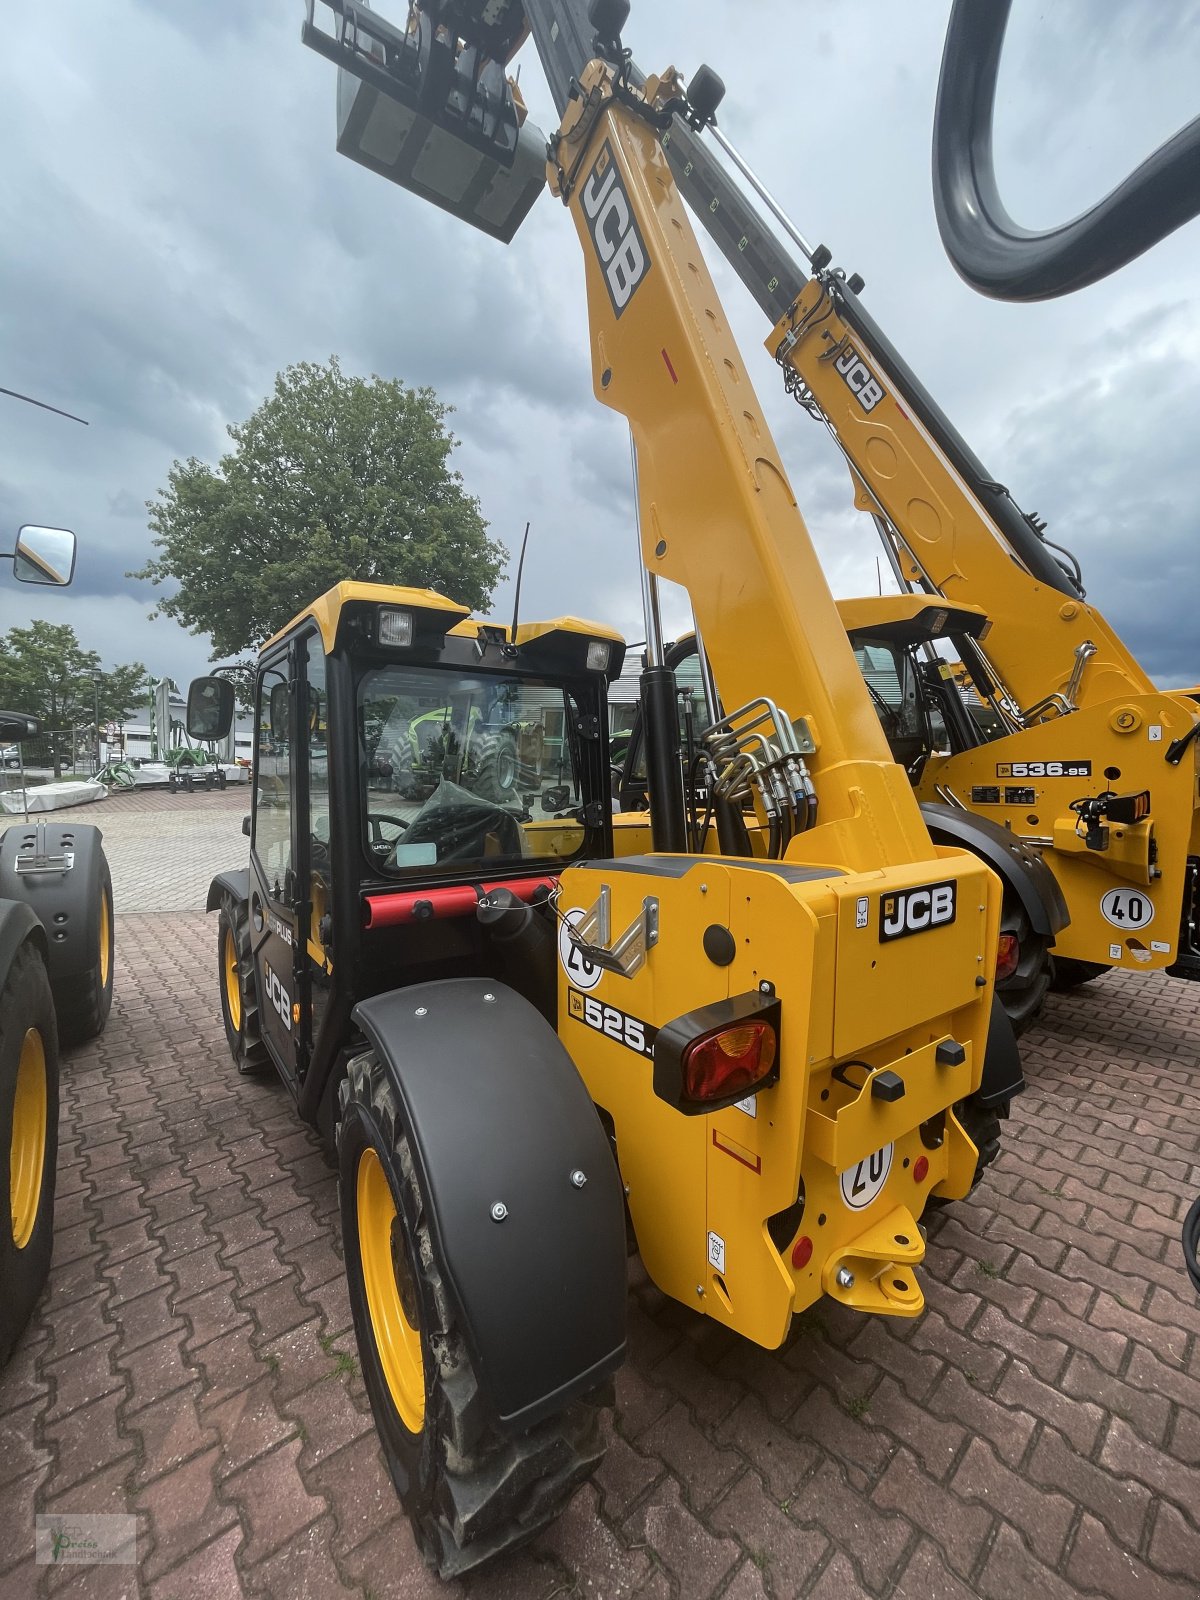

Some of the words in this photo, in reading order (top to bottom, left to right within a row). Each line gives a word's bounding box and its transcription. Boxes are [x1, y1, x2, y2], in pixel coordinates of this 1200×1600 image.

[584, 167, 644, 308] JCB
[836, 354, 882, 410] JCB
[1012, 762, 1088, 777] 536-95
[884, 886, 952, 935] JCB
[1112, 895, 1142, 921] 40
[265, 966, 291, 1031] JCB
[585, 997, 655, 1057] 525-
